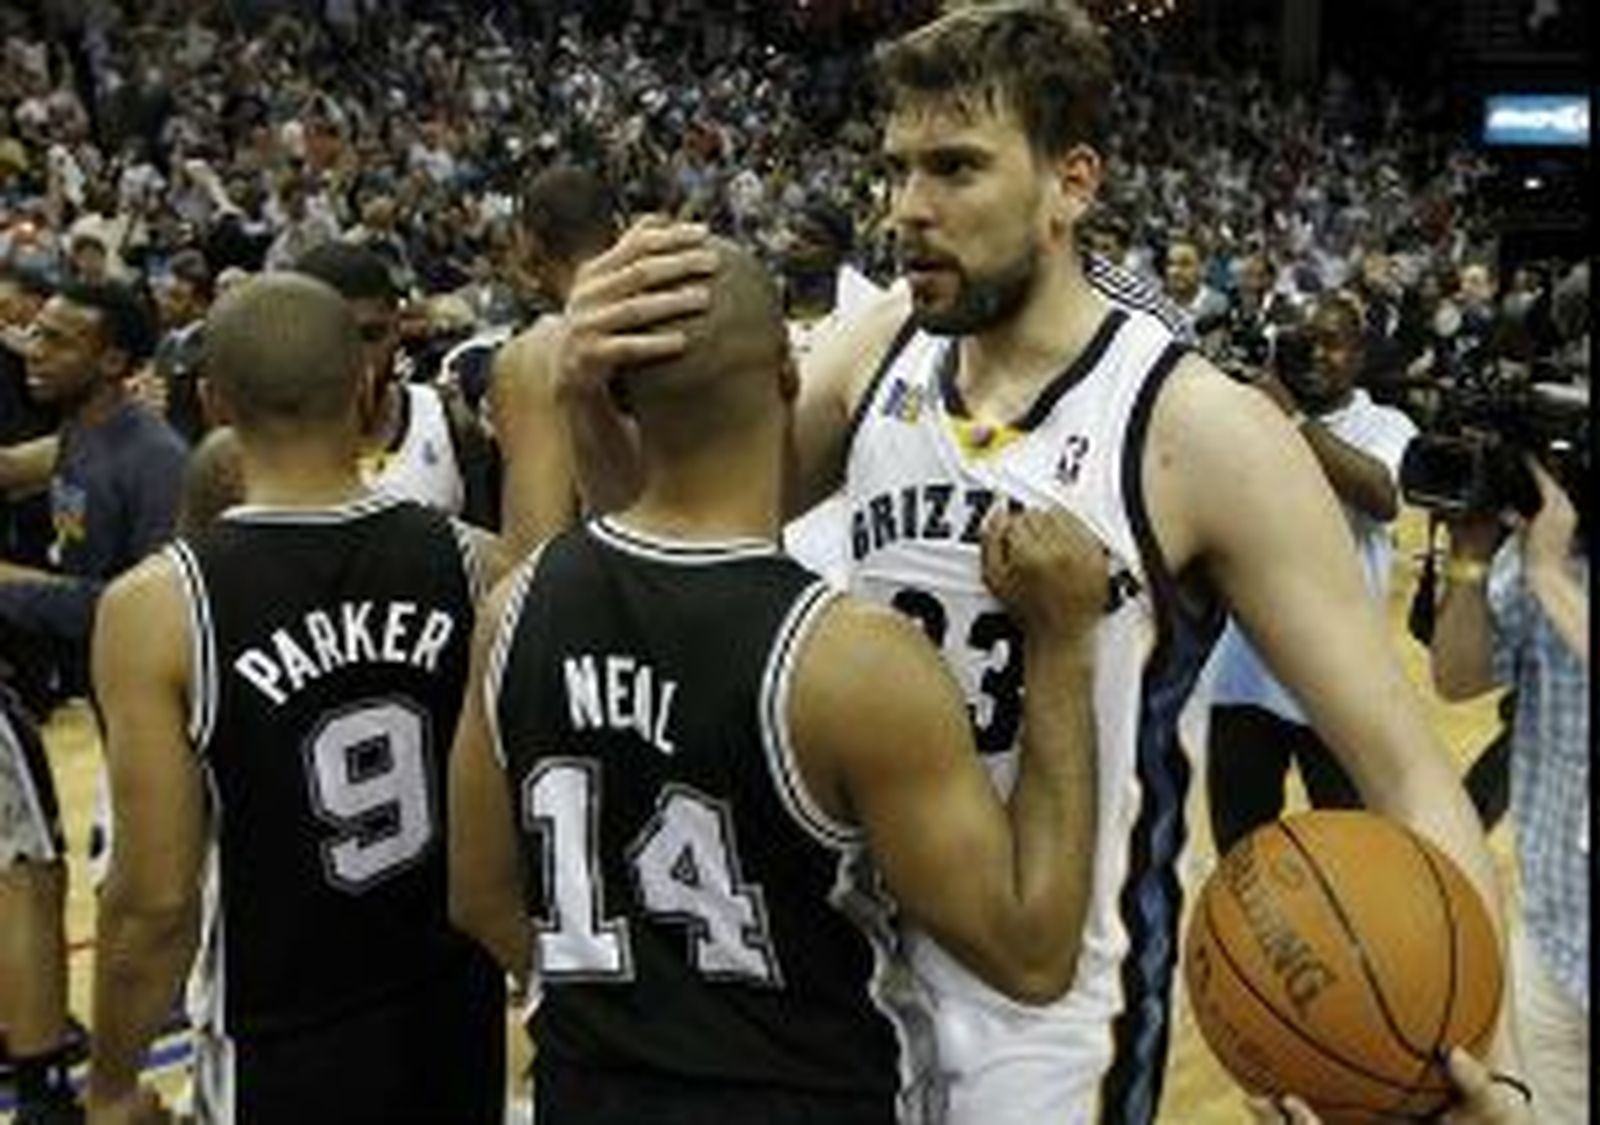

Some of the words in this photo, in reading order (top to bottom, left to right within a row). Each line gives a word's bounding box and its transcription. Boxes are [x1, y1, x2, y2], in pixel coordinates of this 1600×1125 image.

[235, 602, 453, 704] PARKER
[563, 653, 677, 755] NEAL
[307, 699, 434, 893] 9
[522, 757, 785, 987] 14
